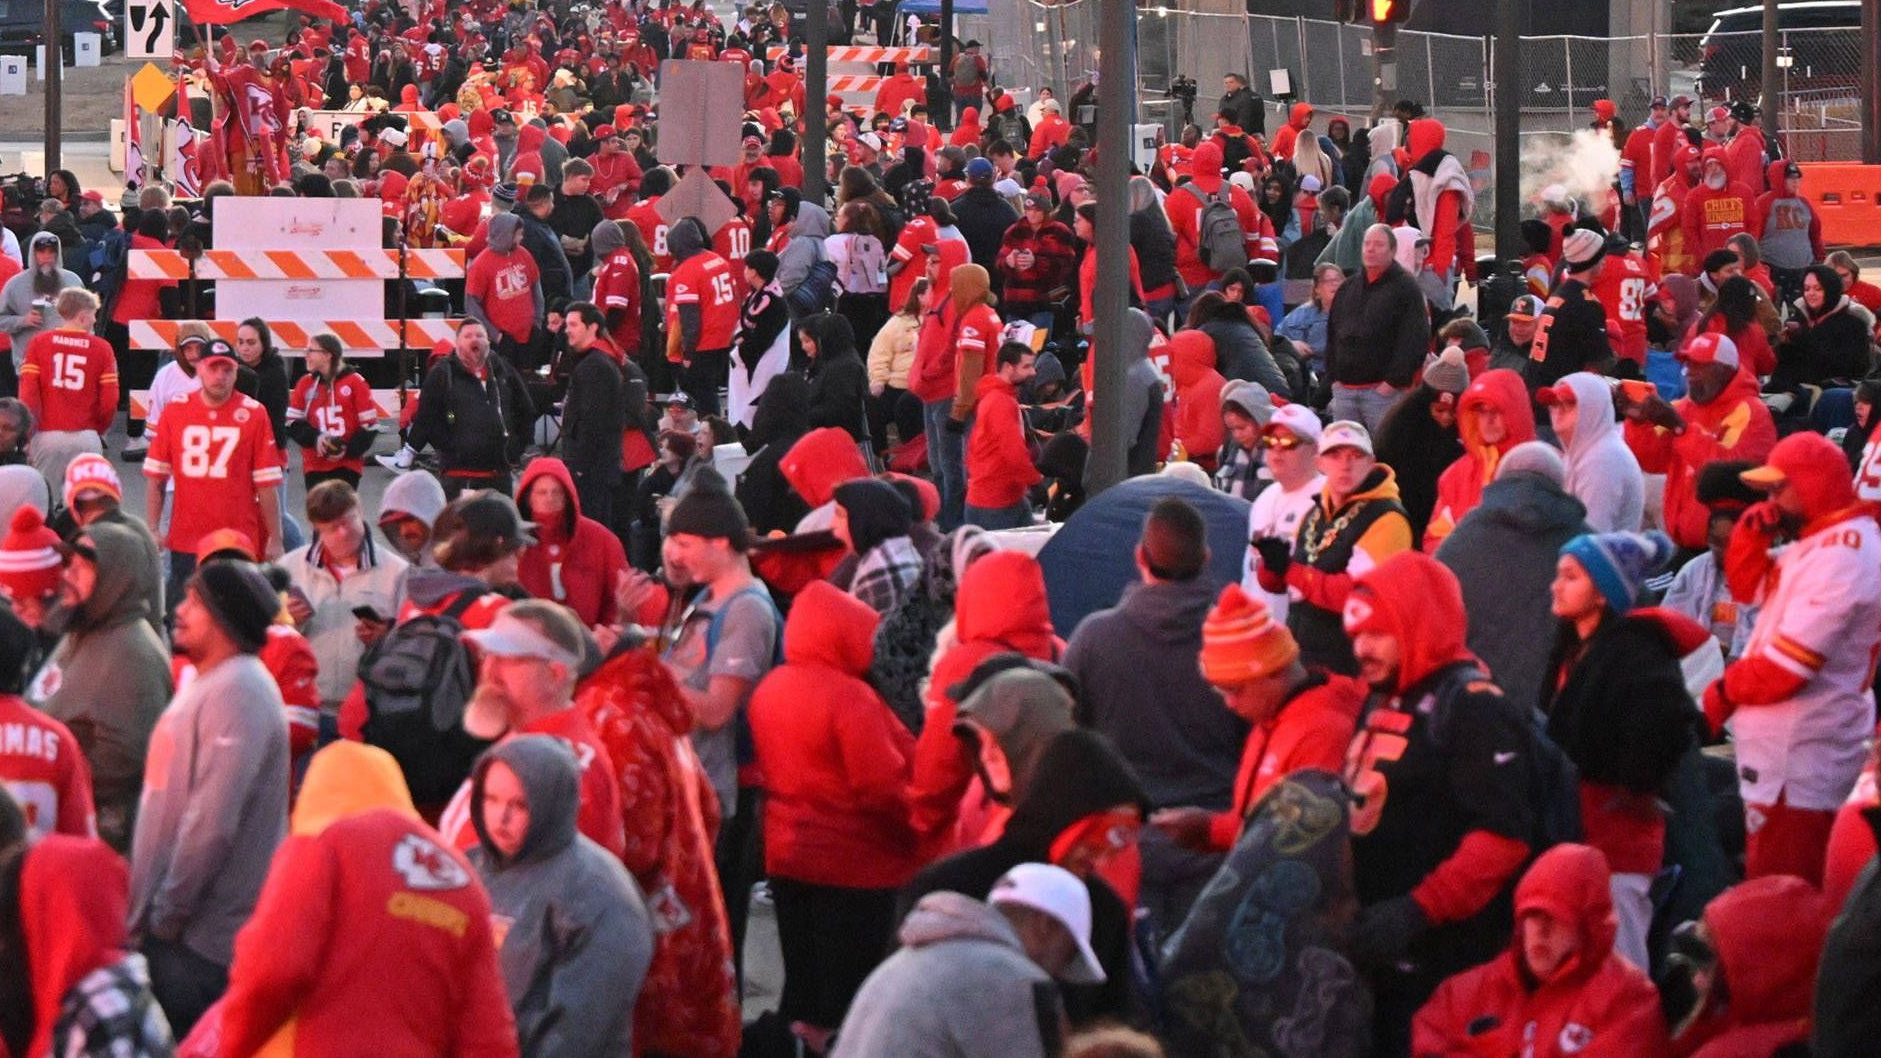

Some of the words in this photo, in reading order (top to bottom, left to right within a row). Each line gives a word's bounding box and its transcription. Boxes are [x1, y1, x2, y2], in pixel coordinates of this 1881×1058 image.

[729, 228, 751, 260] 10
[711, 272, 734, 306] 15
[51, 352, 88, 391] 15
[316, 405, 346, 437] 15
[182, 425, 241, 479] 87
